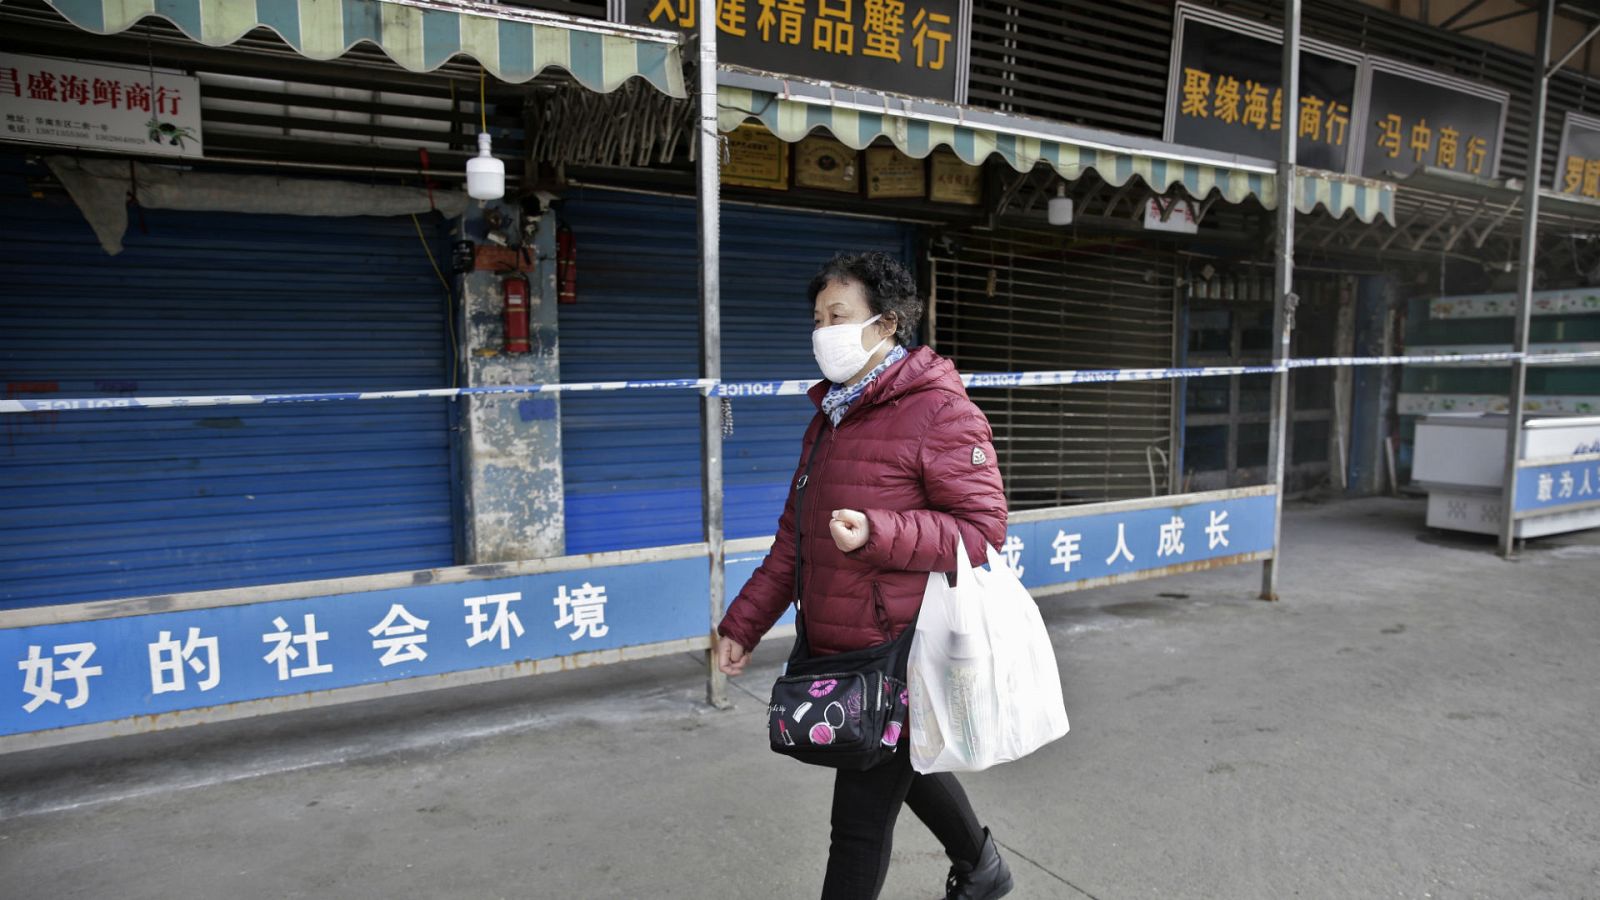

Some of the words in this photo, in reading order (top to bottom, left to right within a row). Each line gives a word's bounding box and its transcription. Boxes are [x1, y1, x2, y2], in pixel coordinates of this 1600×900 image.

[0, 67, 182, 116] 昌盛海鲜商行
[1377, 113, 1487, 174] 冯中商行
[718, 382, 774, 396] POLICE
[1537, 468, 1600, 502] 敢为人
[1001, 510, 1230, 579] 成年人成长
[18, 582, 609, 714] 好的社会环境
